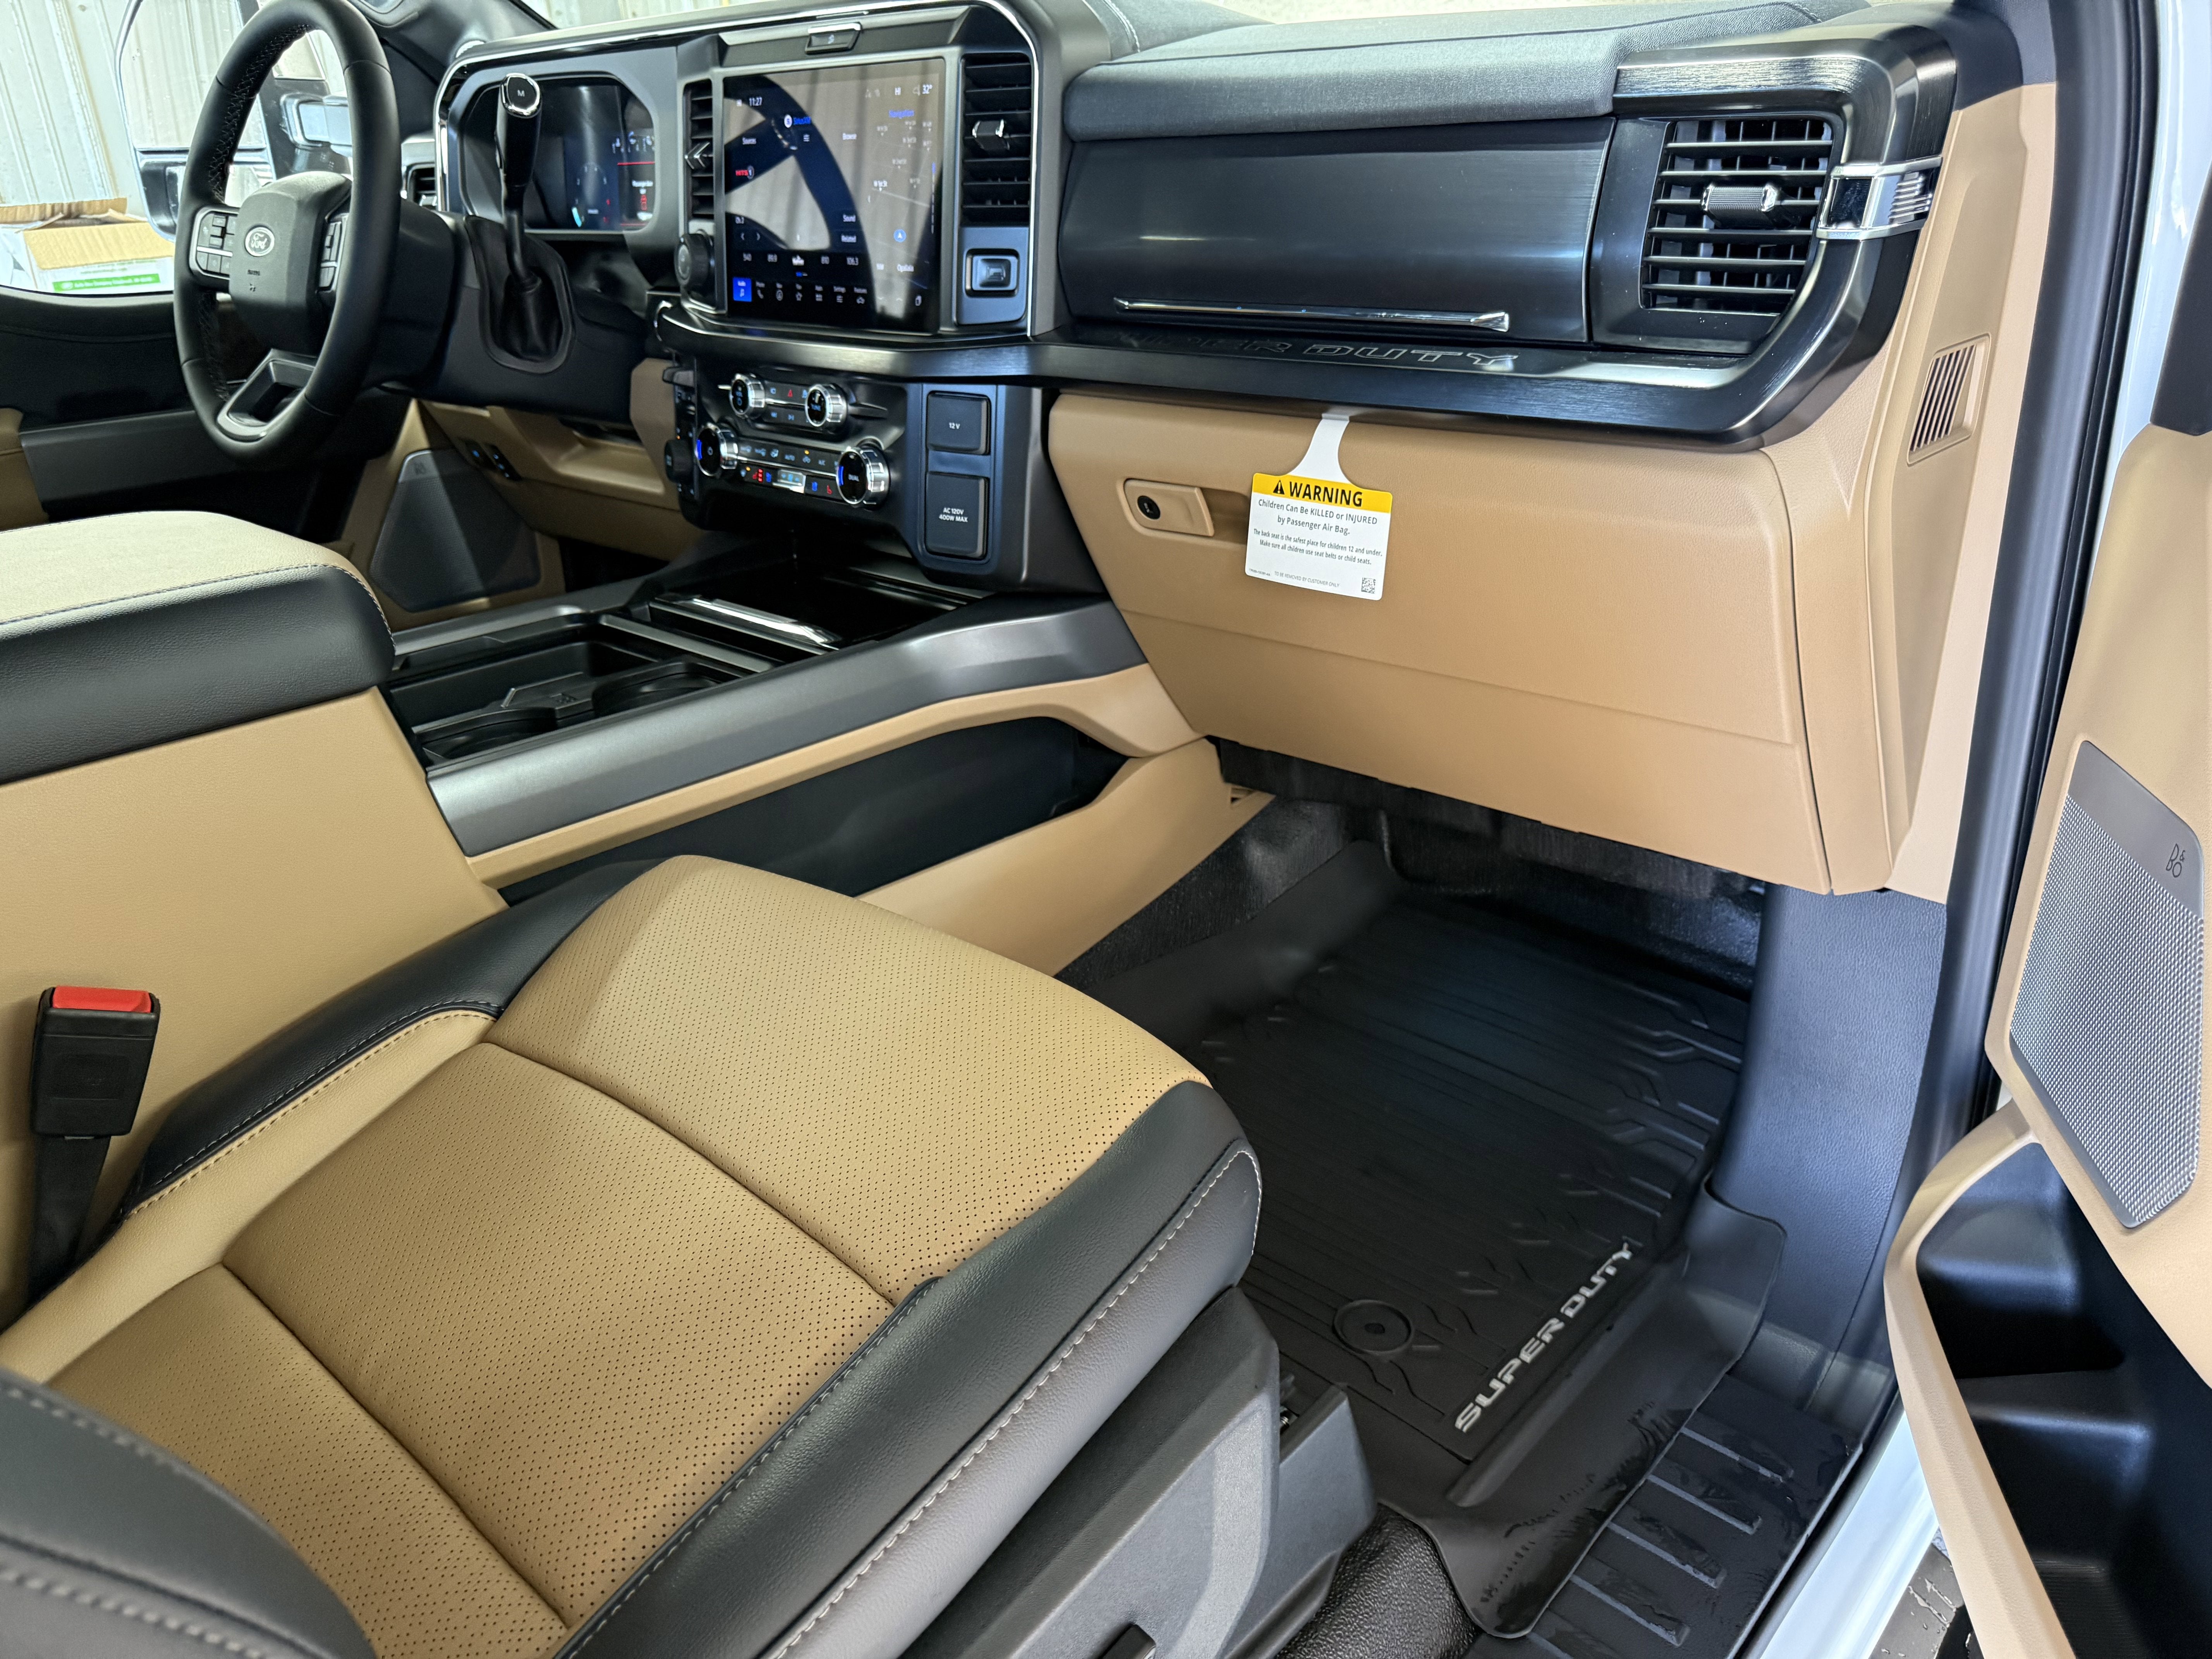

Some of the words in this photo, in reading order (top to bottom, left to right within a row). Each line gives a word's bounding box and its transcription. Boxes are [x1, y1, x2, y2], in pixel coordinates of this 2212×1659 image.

[749, 96, 762, 106] 11:27
[251, 233, 268, 249] Ford
[1302, 343, 1518, 366] DUTY
[1289, 481, 1363, 507] WARNING
[1259, 499, 1284, 510] Children
[1286, 504, 1298, 513] Can
[1300, 507, 1309, 515] Be
[1310, 508, 1334, 518] KILLED
[1346, 514, 1377, 525] INJURED
[1278, 515, 1285, 525] by
[1287, 517, 1321, 530] Passenger
[1322, 523, 1333, 532] Air
[1335, 525, 1350, 536] Bag.
[1260, 539, 1271, 547] Make
[1287, 546, 1304, 554] children
[1325, 551, 1337, 560] belts
[1307, 539, 1319, 547] place
[1328, 542, 1347, 551] children
[1307, 578, 1328, 586] CUSTOMER
[1455, 1317, 1565, 1432] SUPER
[1560, 1242, 1633, 1318] DUTY
